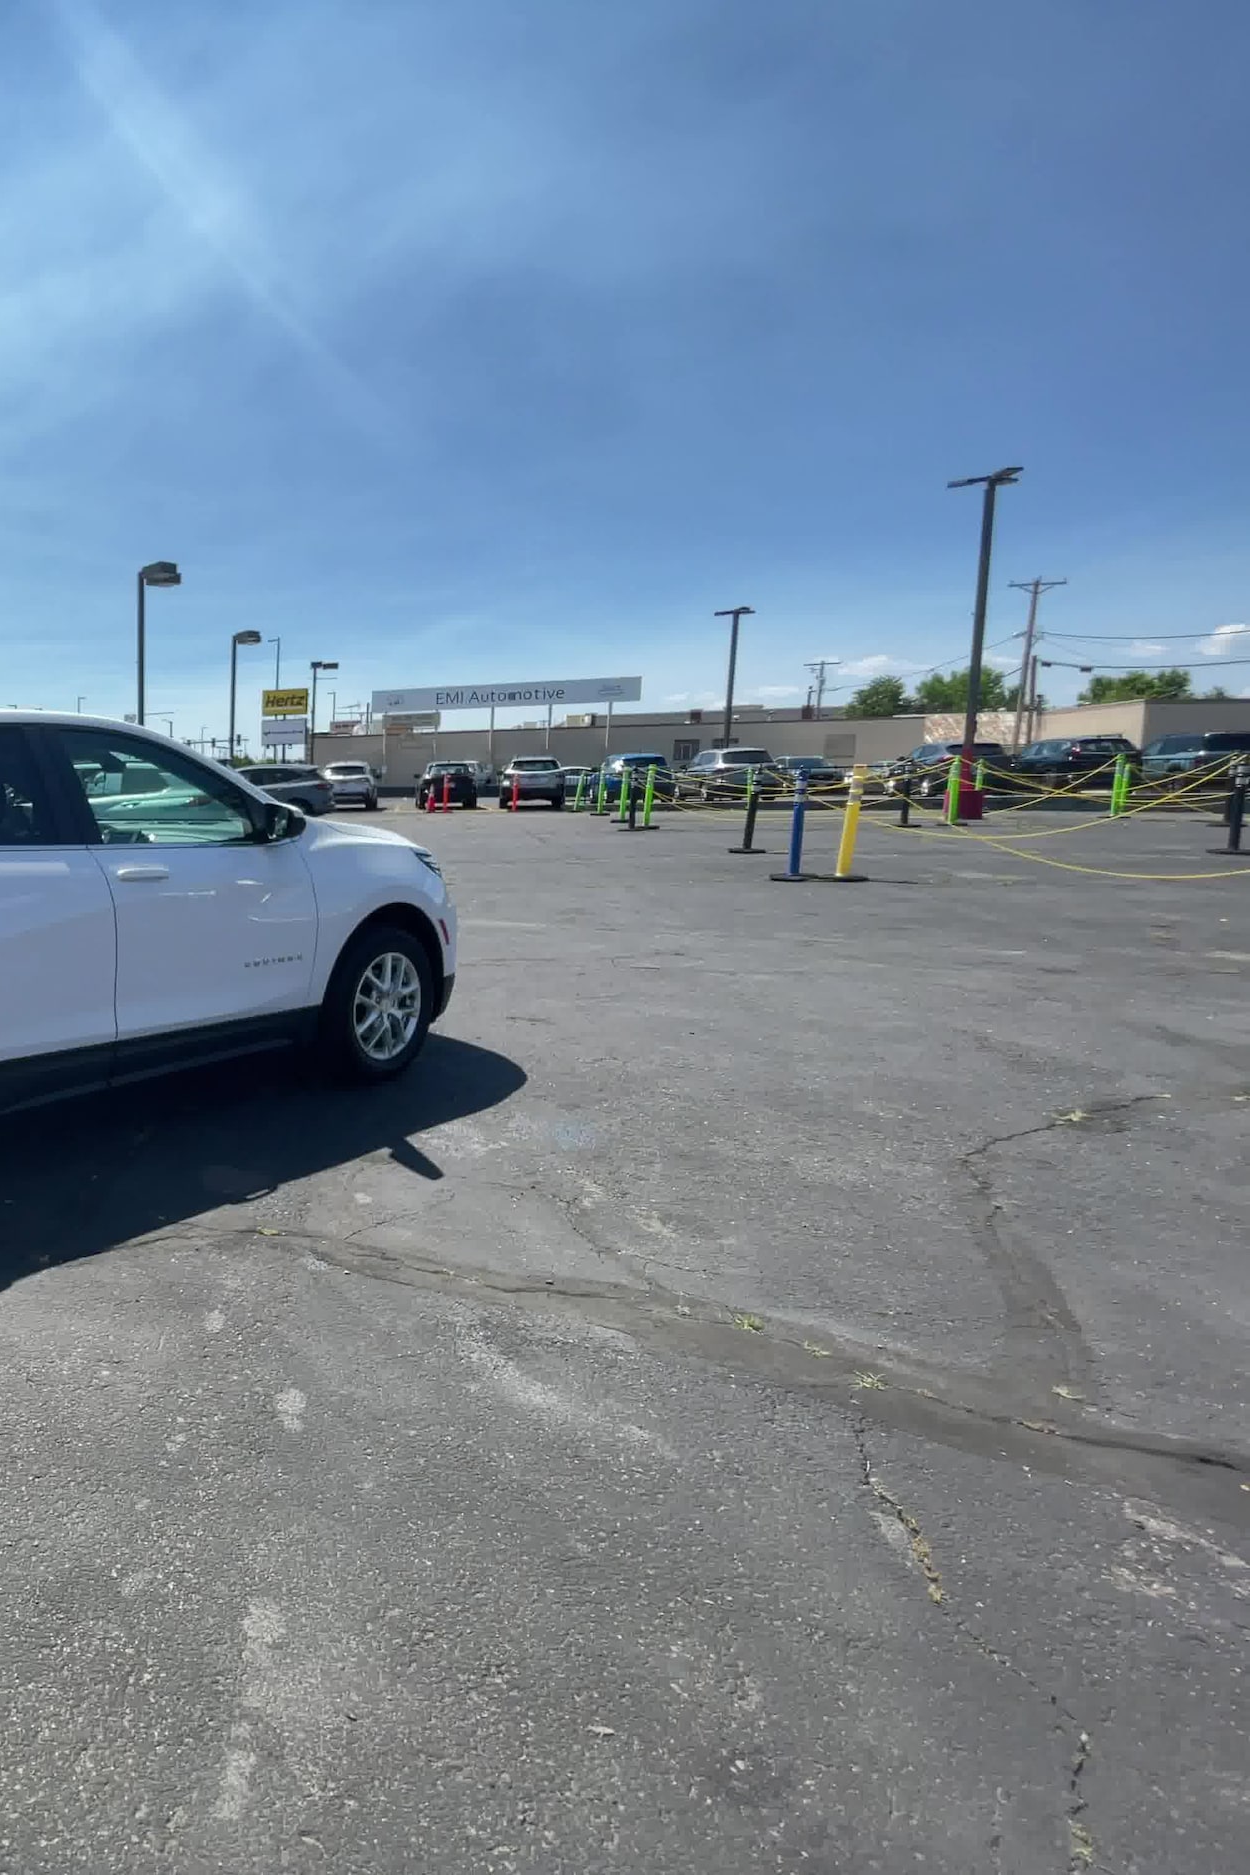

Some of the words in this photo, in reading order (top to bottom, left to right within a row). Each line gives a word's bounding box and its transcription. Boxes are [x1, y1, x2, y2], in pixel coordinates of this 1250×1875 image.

[265, 693, 305, 708] Hertz
[435, 691, 464, 705] EMI
[470, 687, 566, 704] Automotive
